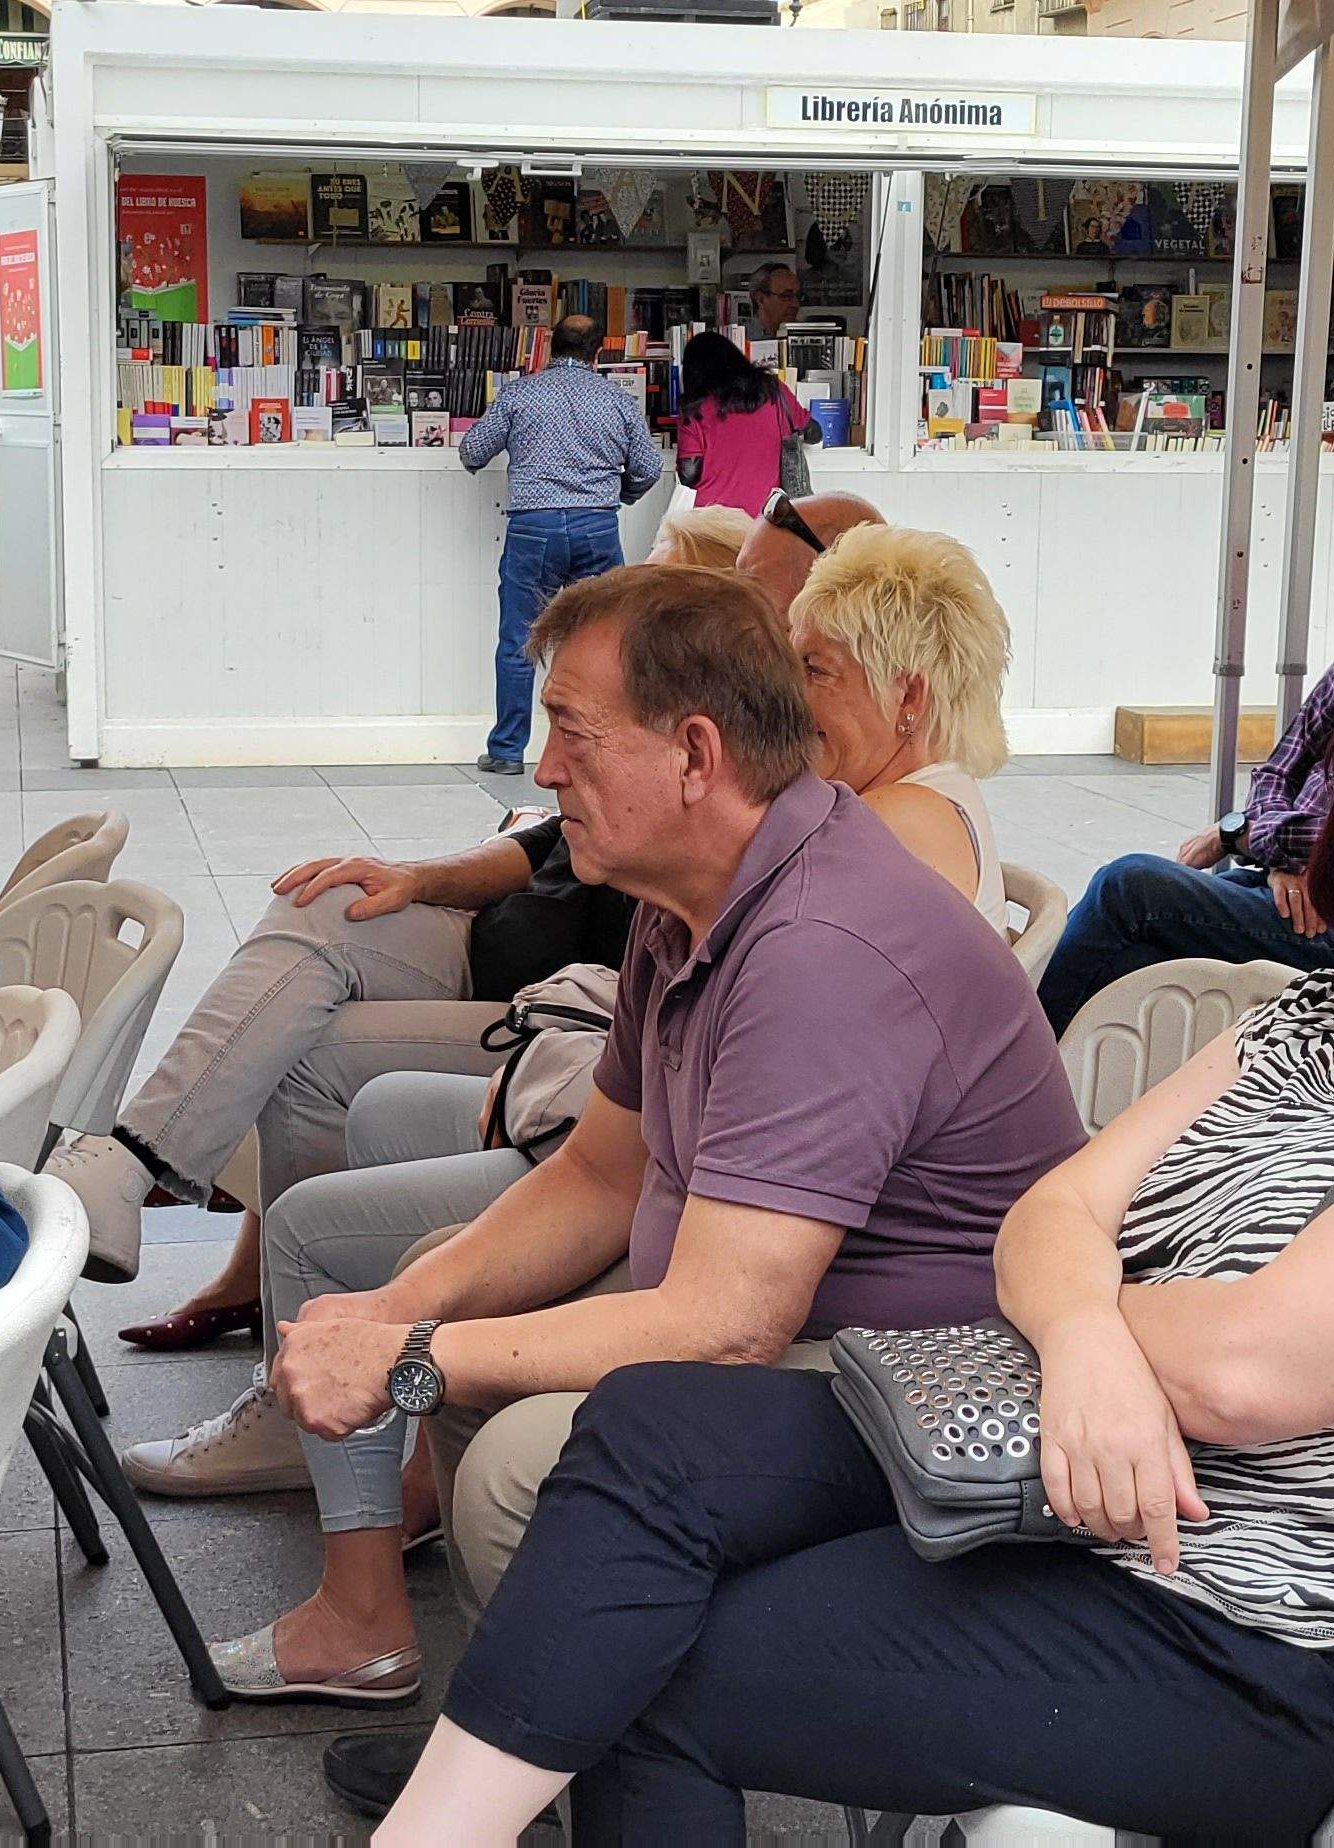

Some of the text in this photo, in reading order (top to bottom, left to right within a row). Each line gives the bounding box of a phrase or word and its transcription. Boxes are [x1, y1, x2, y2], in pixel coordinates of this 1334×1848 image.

[801, 95, 1002, 126] Librería Anónima
[1154, 238, 1206, 251] VEGETAL
